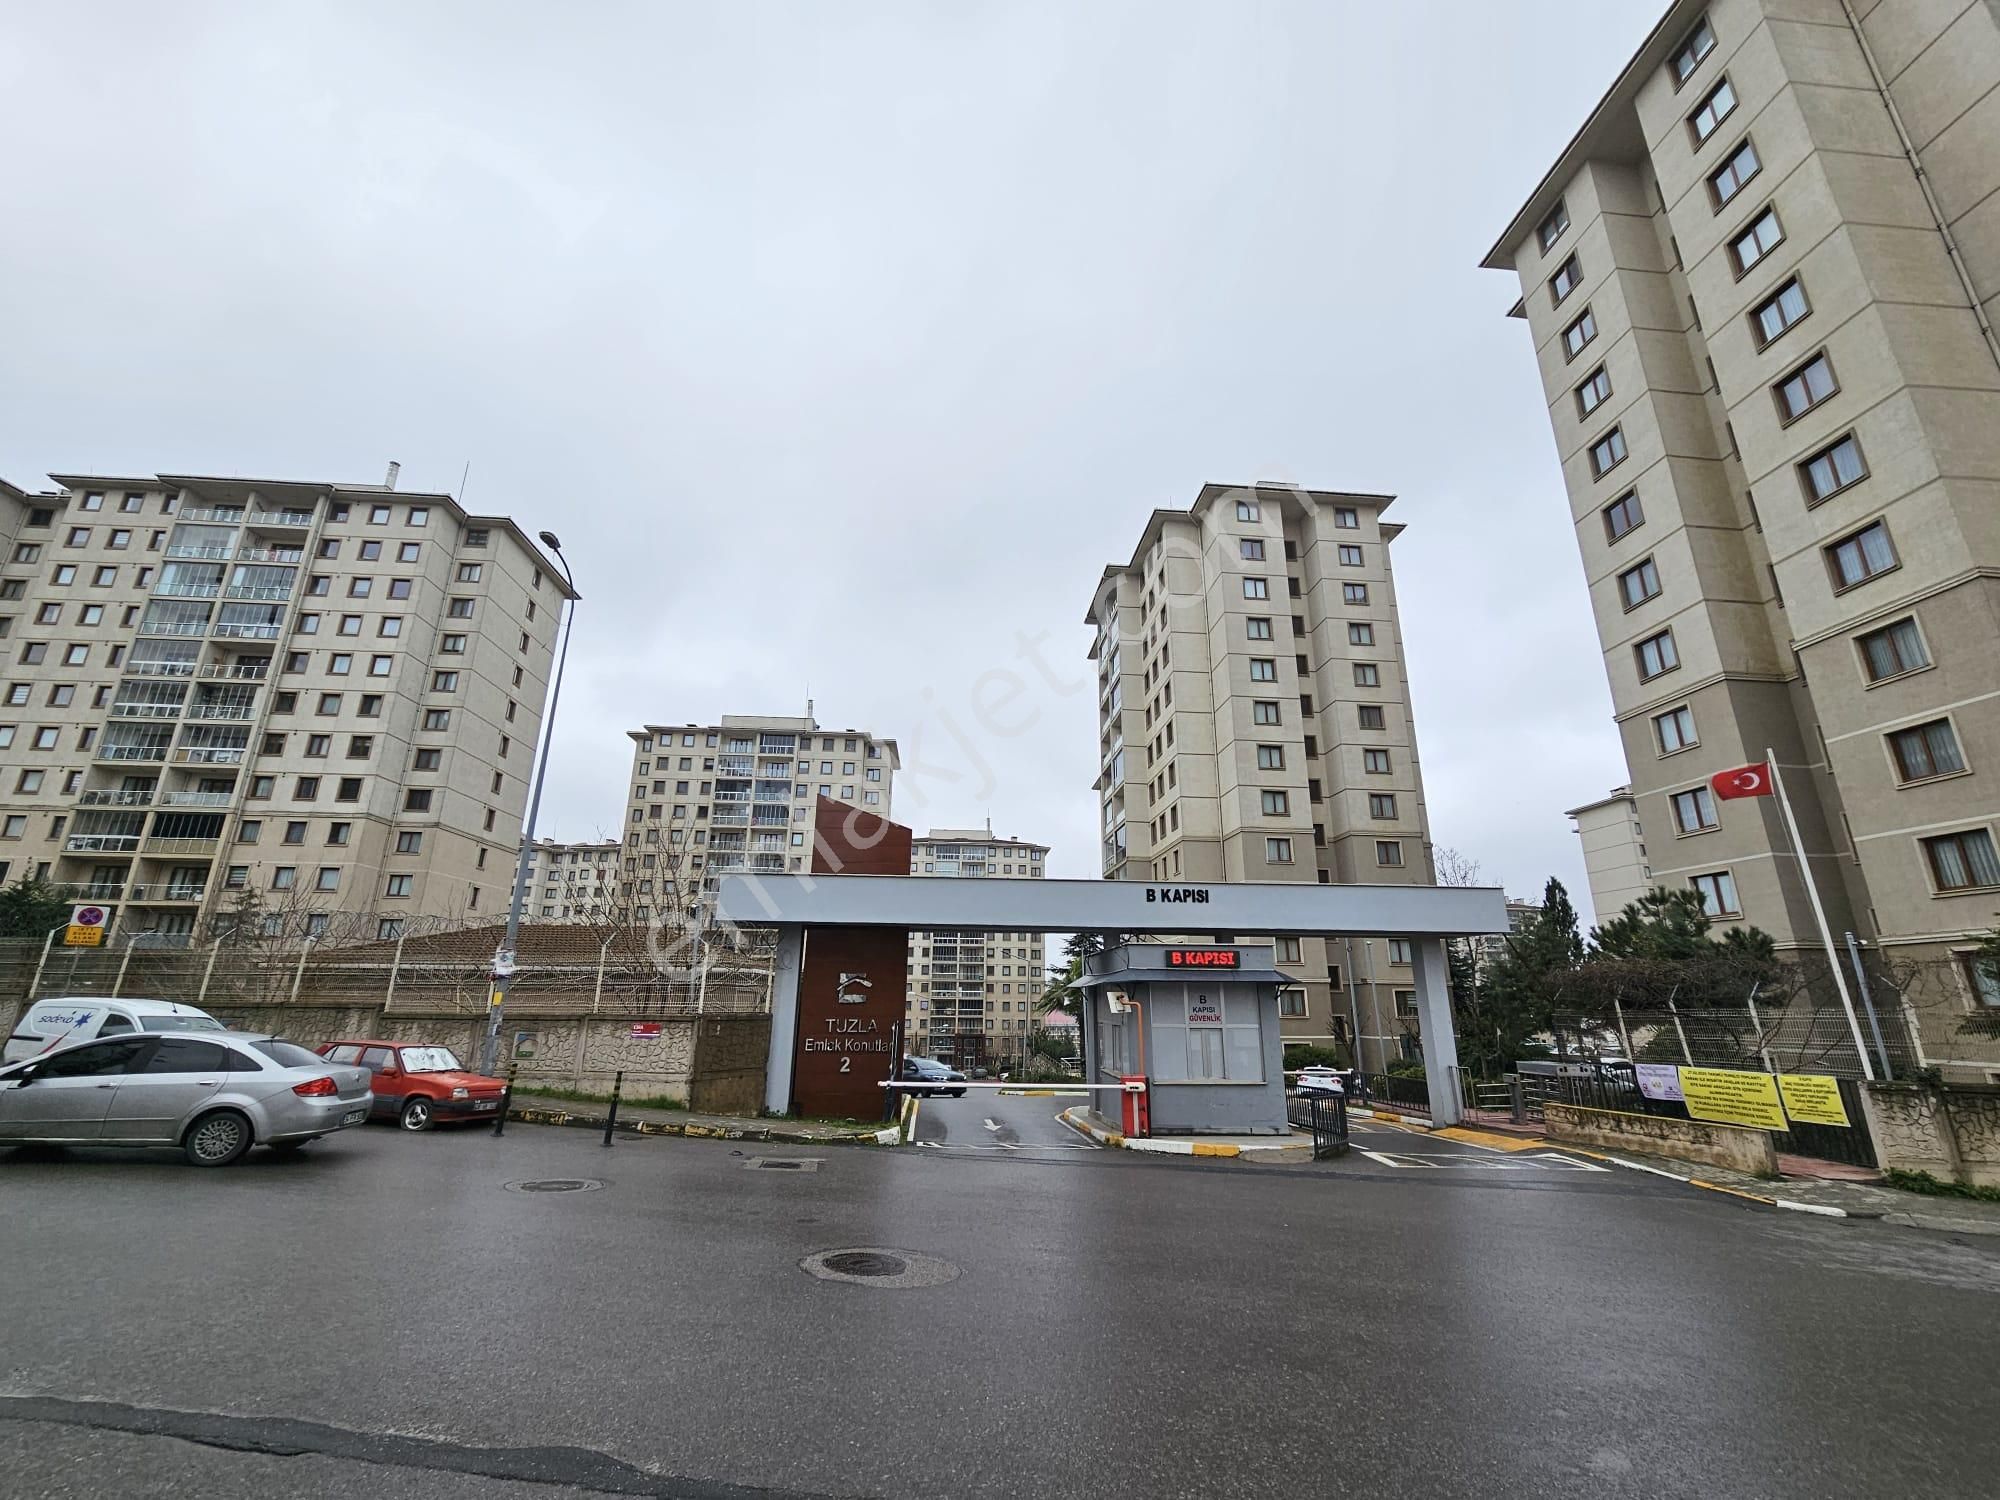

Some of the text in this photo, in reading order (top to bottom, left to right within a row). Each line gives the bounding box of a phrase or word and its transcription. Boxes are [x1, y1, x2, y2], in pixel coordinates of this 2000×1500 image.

[1146, 889, 1209, 903] B KAPISI
[1172, 952, 1235, 965] B KAPISI
[1199, 995, 1207, 1004] B
[825, 1018, 879, 1033] TUZLA
[805, 1038, 842, 1052] Emlak
[840, 1056, 851, 1073] 2
